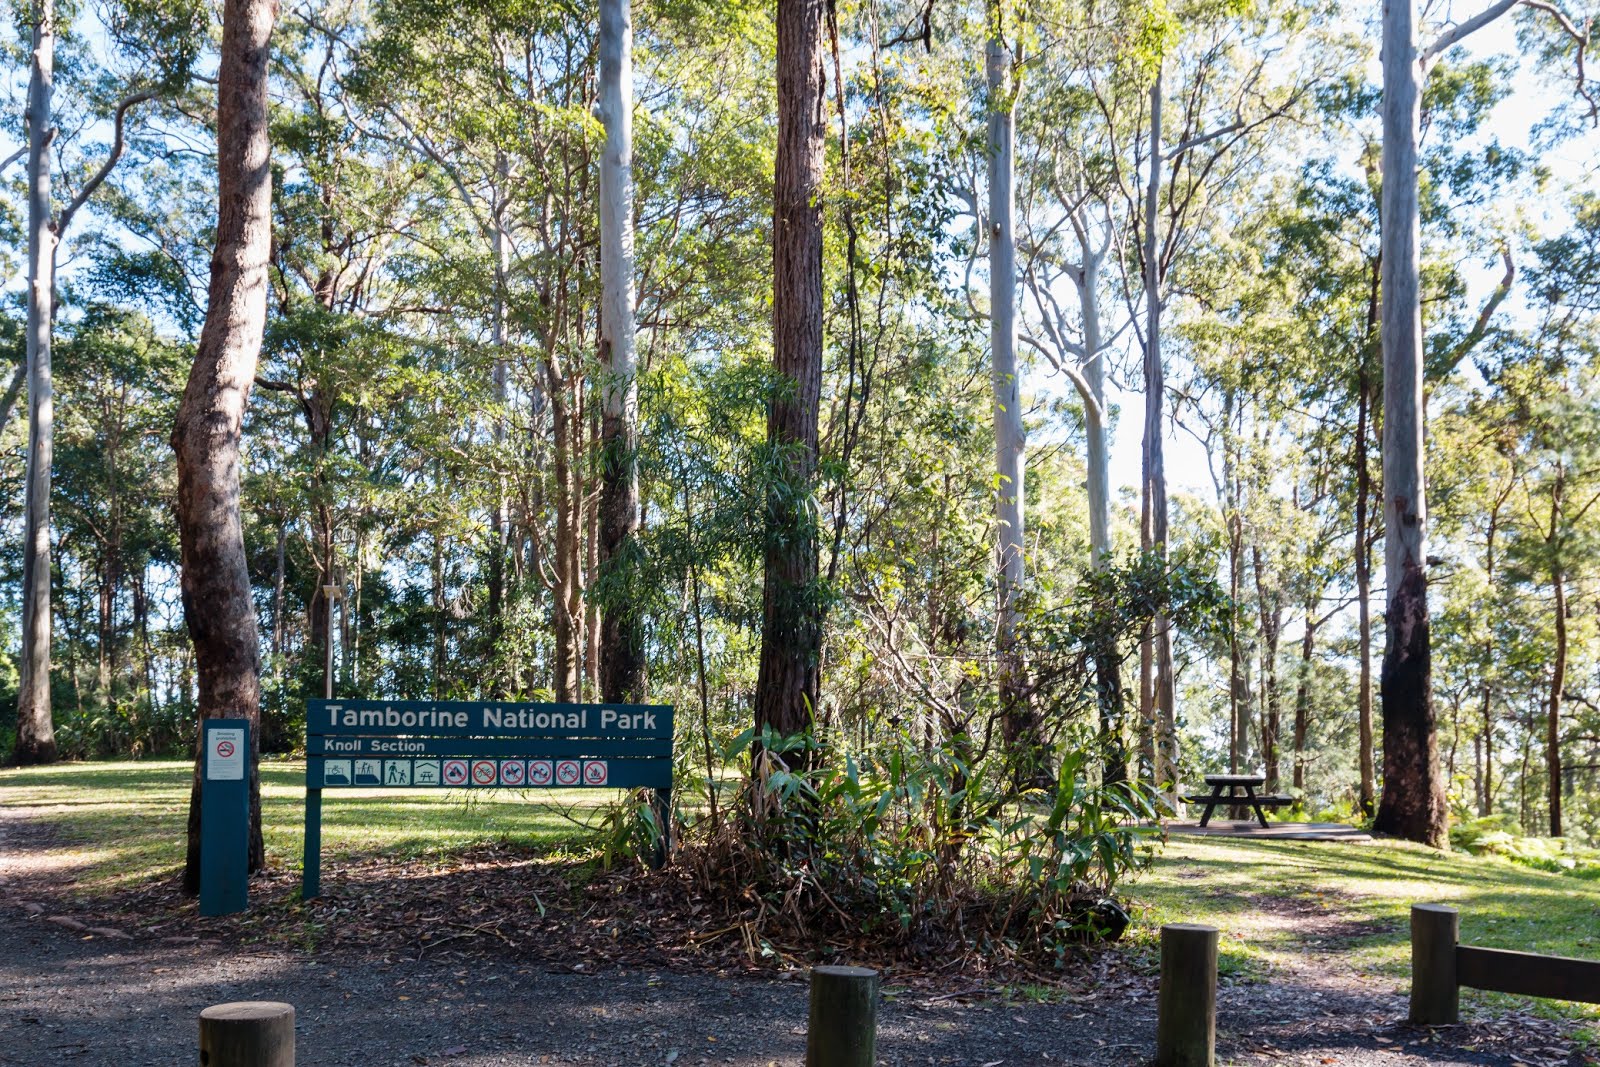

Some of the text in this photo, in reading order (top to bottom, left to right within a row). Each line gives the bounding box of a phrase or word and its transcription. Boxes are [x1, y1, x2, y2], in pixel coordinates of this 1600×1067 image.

[325, 705, 657, 730] Tamborine National Park
[324, 740, 425, 752] Knoll Section
